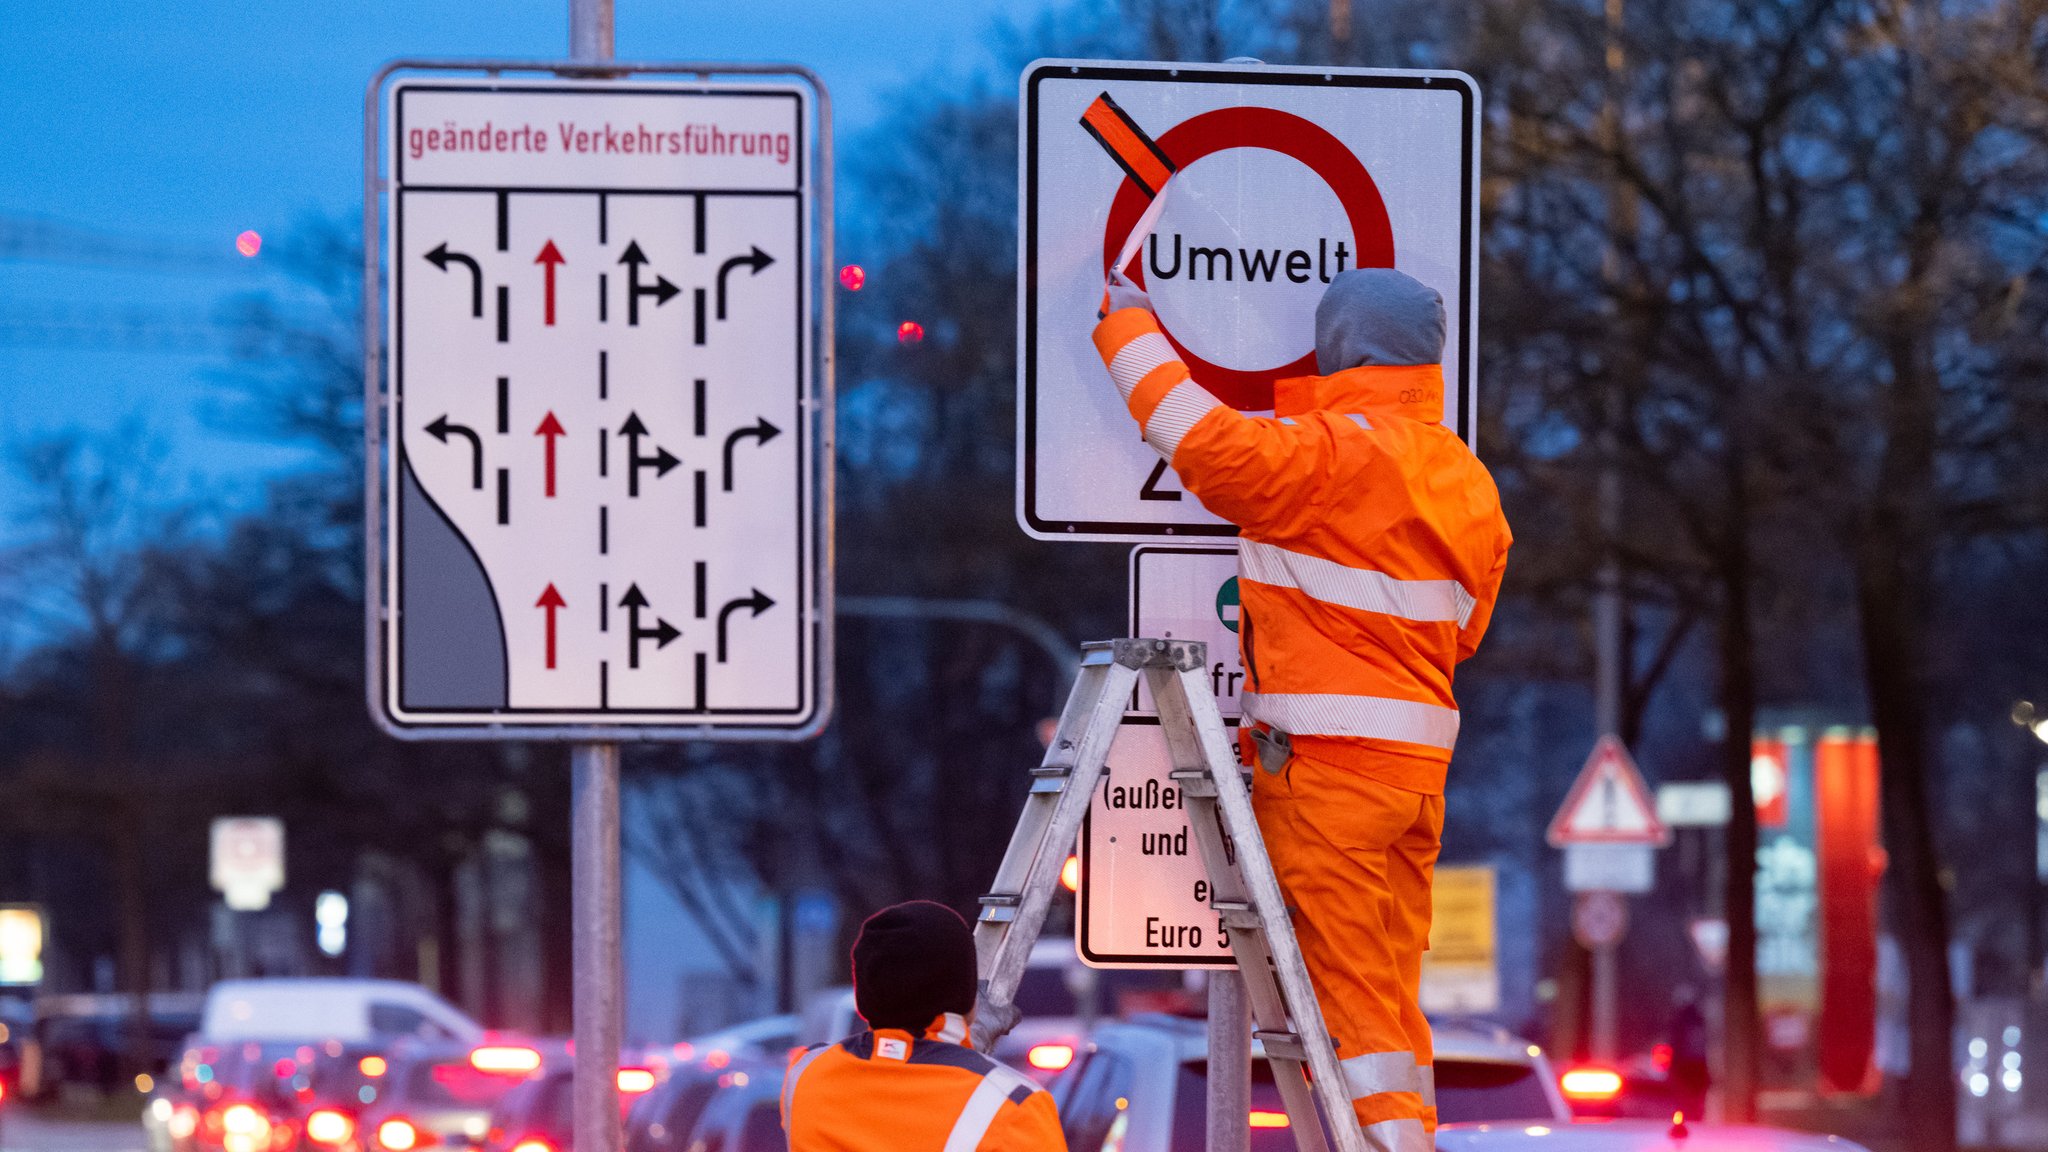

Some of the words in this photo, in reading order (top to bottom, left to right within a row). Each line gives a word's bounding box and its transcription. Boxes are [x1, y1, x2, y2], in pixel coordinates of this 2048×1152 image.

[409, 120, 548, 160] geänderte
[558, 121, 790, 165] Verkehrsführung
[1149, 233, 1350, 284] Umwelt
[1211, 661, 1244, 698] fr
[1142, 824, 1188, 856] und
[1146, 916, 1202, 949] Euro
